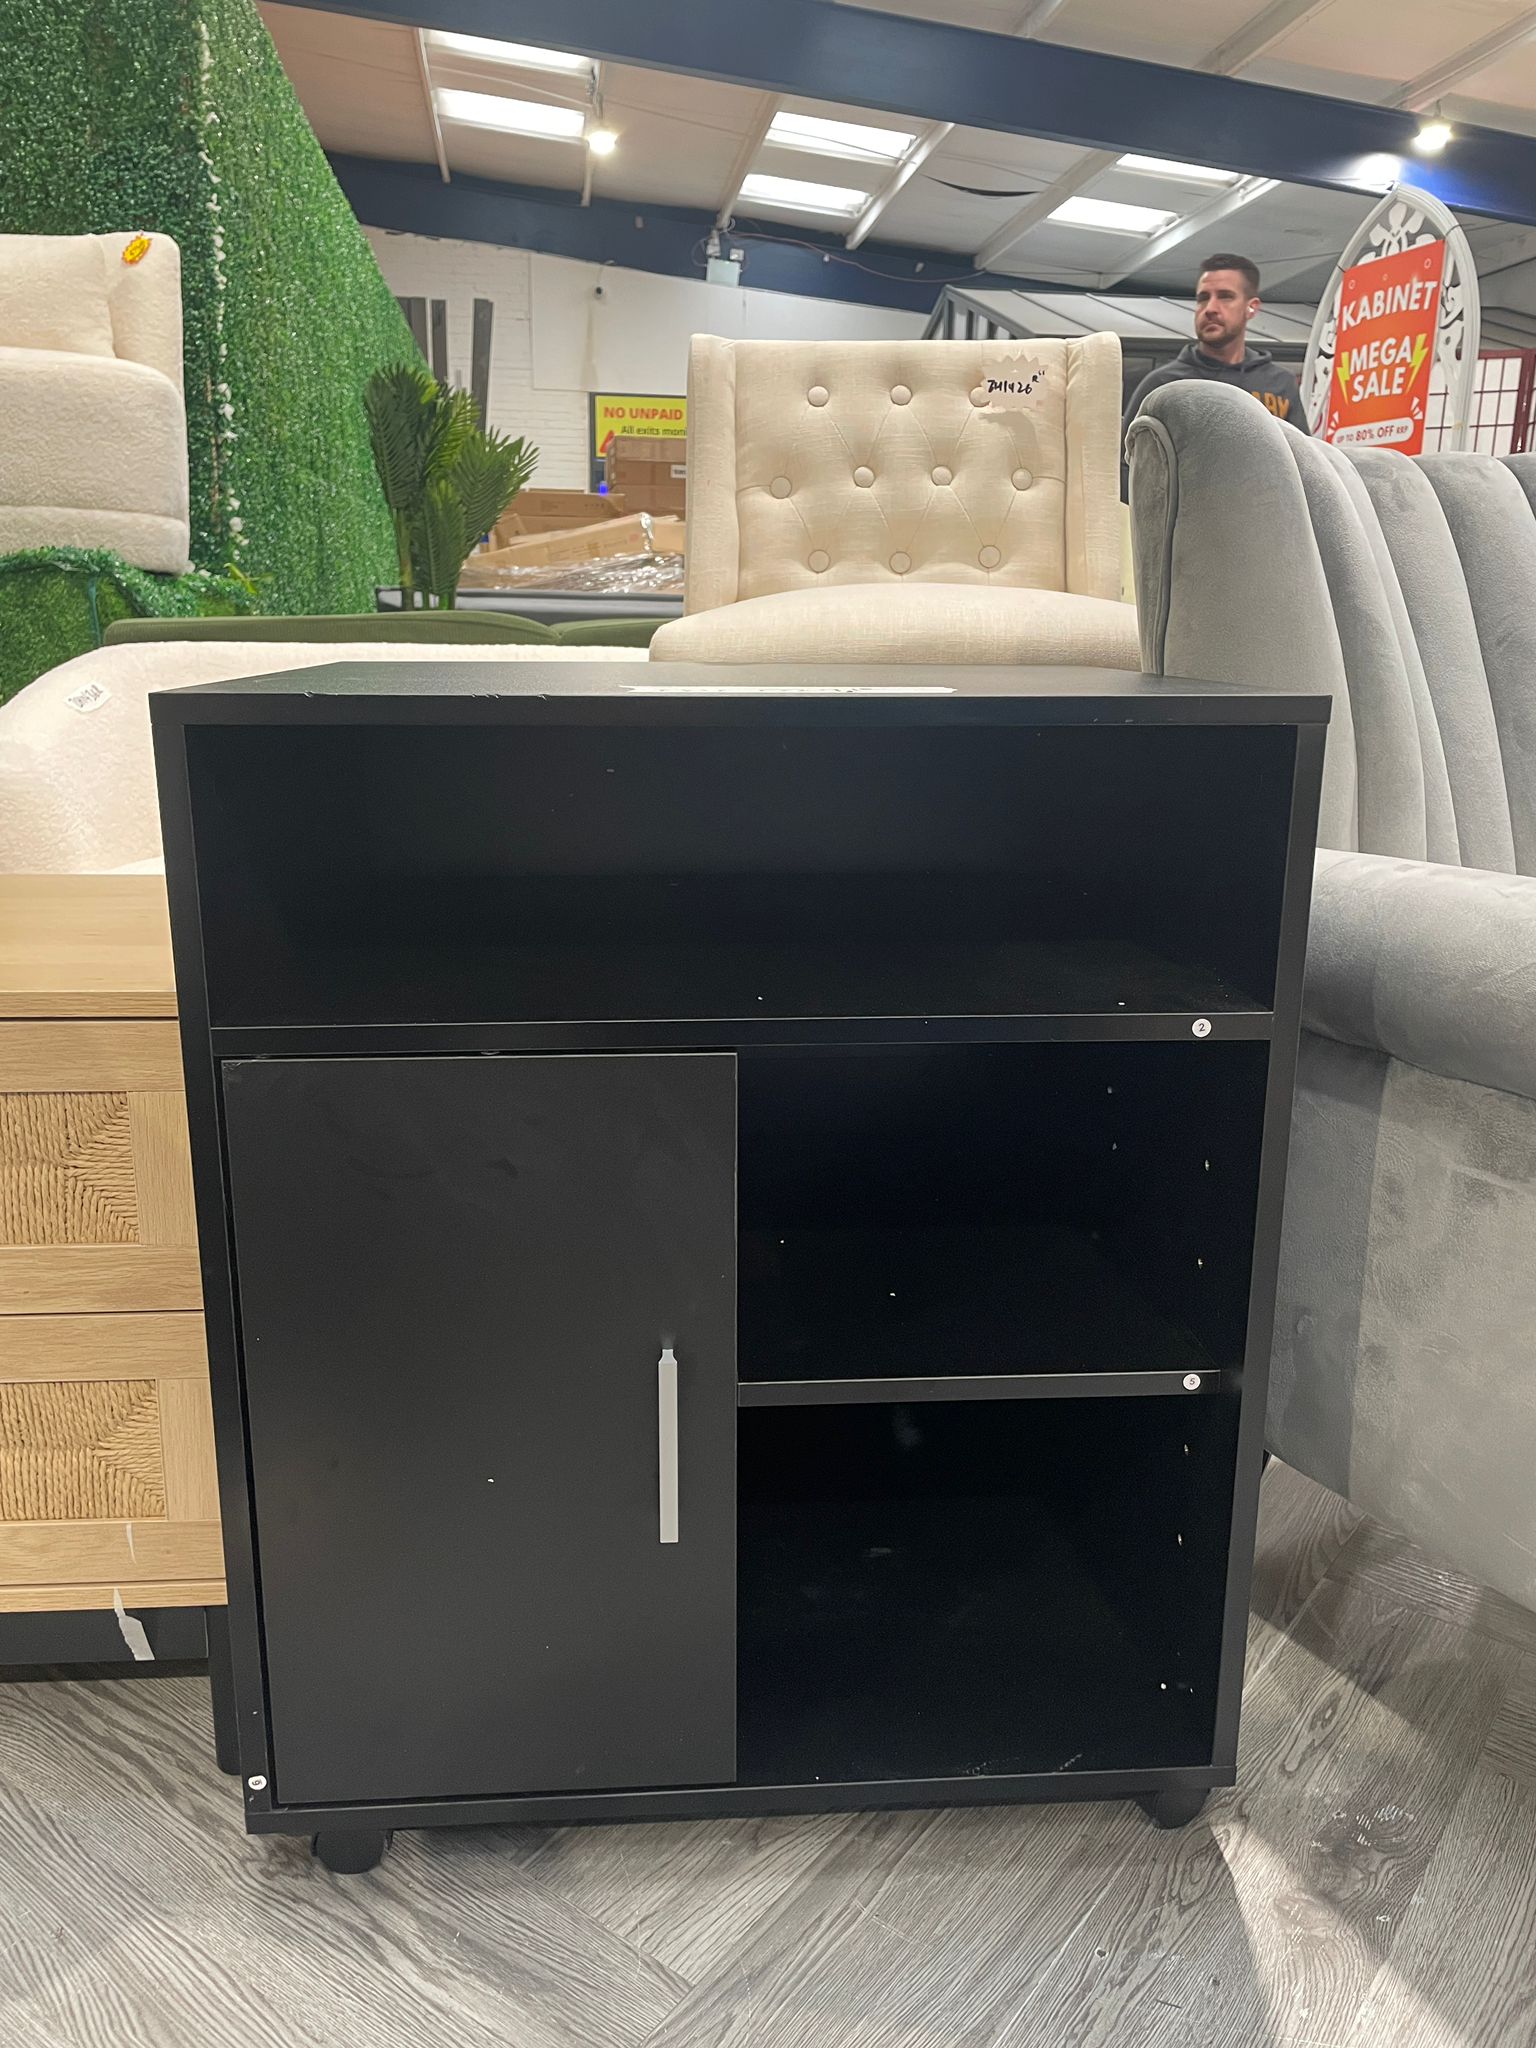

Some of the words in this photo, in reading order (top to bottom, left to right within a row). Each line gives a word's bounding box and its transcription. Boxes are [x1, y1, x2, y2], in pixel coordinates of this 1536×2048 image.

[1341, 280, 1437, 331] KABINET
[1350, 335, 1411, 373] MEGA
[1351, 366, 1405, 403] SALE
[603, 406, 625, 418] NO
[629, 407, 684, 420] UNPAID
[621, 425, 634, 434] All
[636, 426, 660, 435] exits
[1355, 428, 1375, 441] 80%
[1377, 424, 1394, 438] OFF
